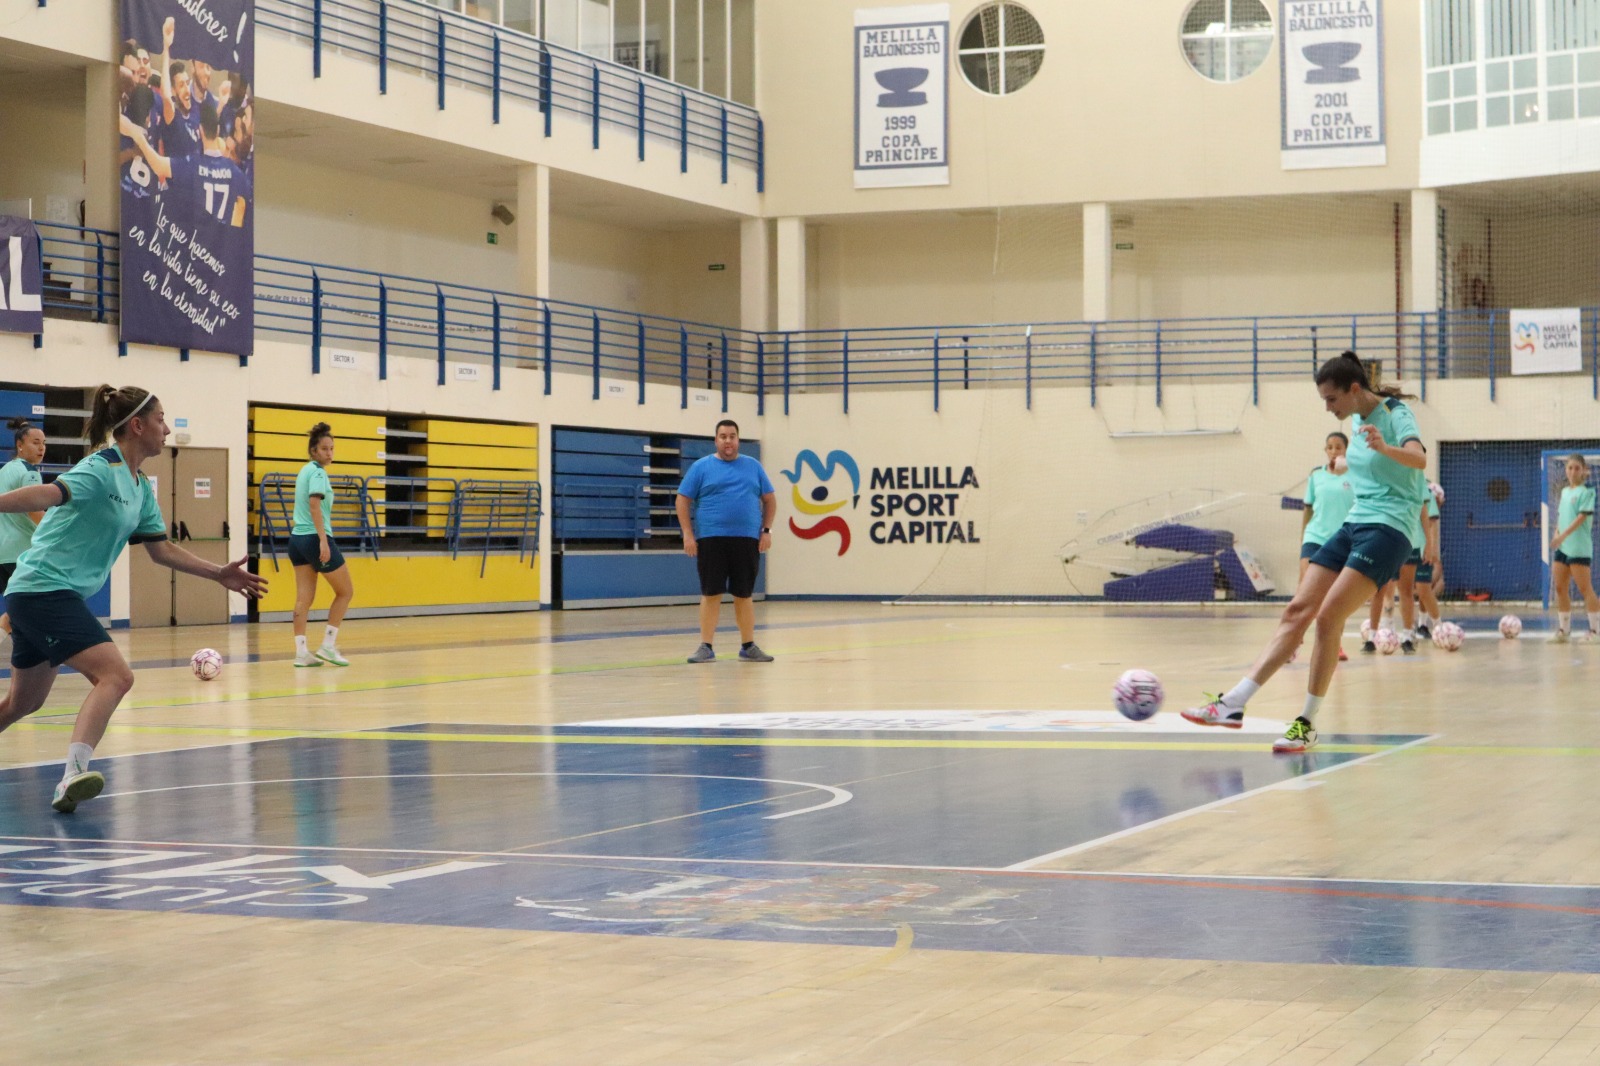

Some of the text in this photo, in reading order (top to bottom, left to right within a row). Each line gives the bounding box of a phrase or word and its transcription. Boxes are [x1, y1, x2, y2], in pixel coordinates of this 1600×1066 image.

[1292, 1, 1370, 17] MELILLA
[1289, 15, 1373, 32] BALONCESTO
[866, 28, 937, 44] MELILLA
[863, 42, 940, 58] BALONCESTO
[1314, 92, 1349, 108] 2001
[884, 115, 916, 131] 1999
[1310, 112, 1354, 127] COPA
[881, 134, 921, 148] COPA
[1293, 125, 1373, 142] PRINCIPE
[865, 147, 938, 163] PRINCIPE
[130, 155, 151, 187] 6
[203, 181, 230, 220] 17
[169, 222, 187, 249] que
[188, 229, 226, 277] hacemos
[0, 235, 42, 312] L
[129, 225, 240, 320] en la vida tiene su eco
[142, 269, 158, 291] en
[160, 271, 173, 301] la
[1542, 324, 1578, 333] MELILLA
[1543, 333, 1571, 341] SPORT
[1543, 341, 1578, 350] CAPITAL
[333, 354, 351, 364] SECTOR
[458, 367, 473, 375] SECTOR
[870, 466, 980, 490] MELILLA
[870, 493, 959, 517] SPORT
[869, 521, 980, 544] CAPITAL
